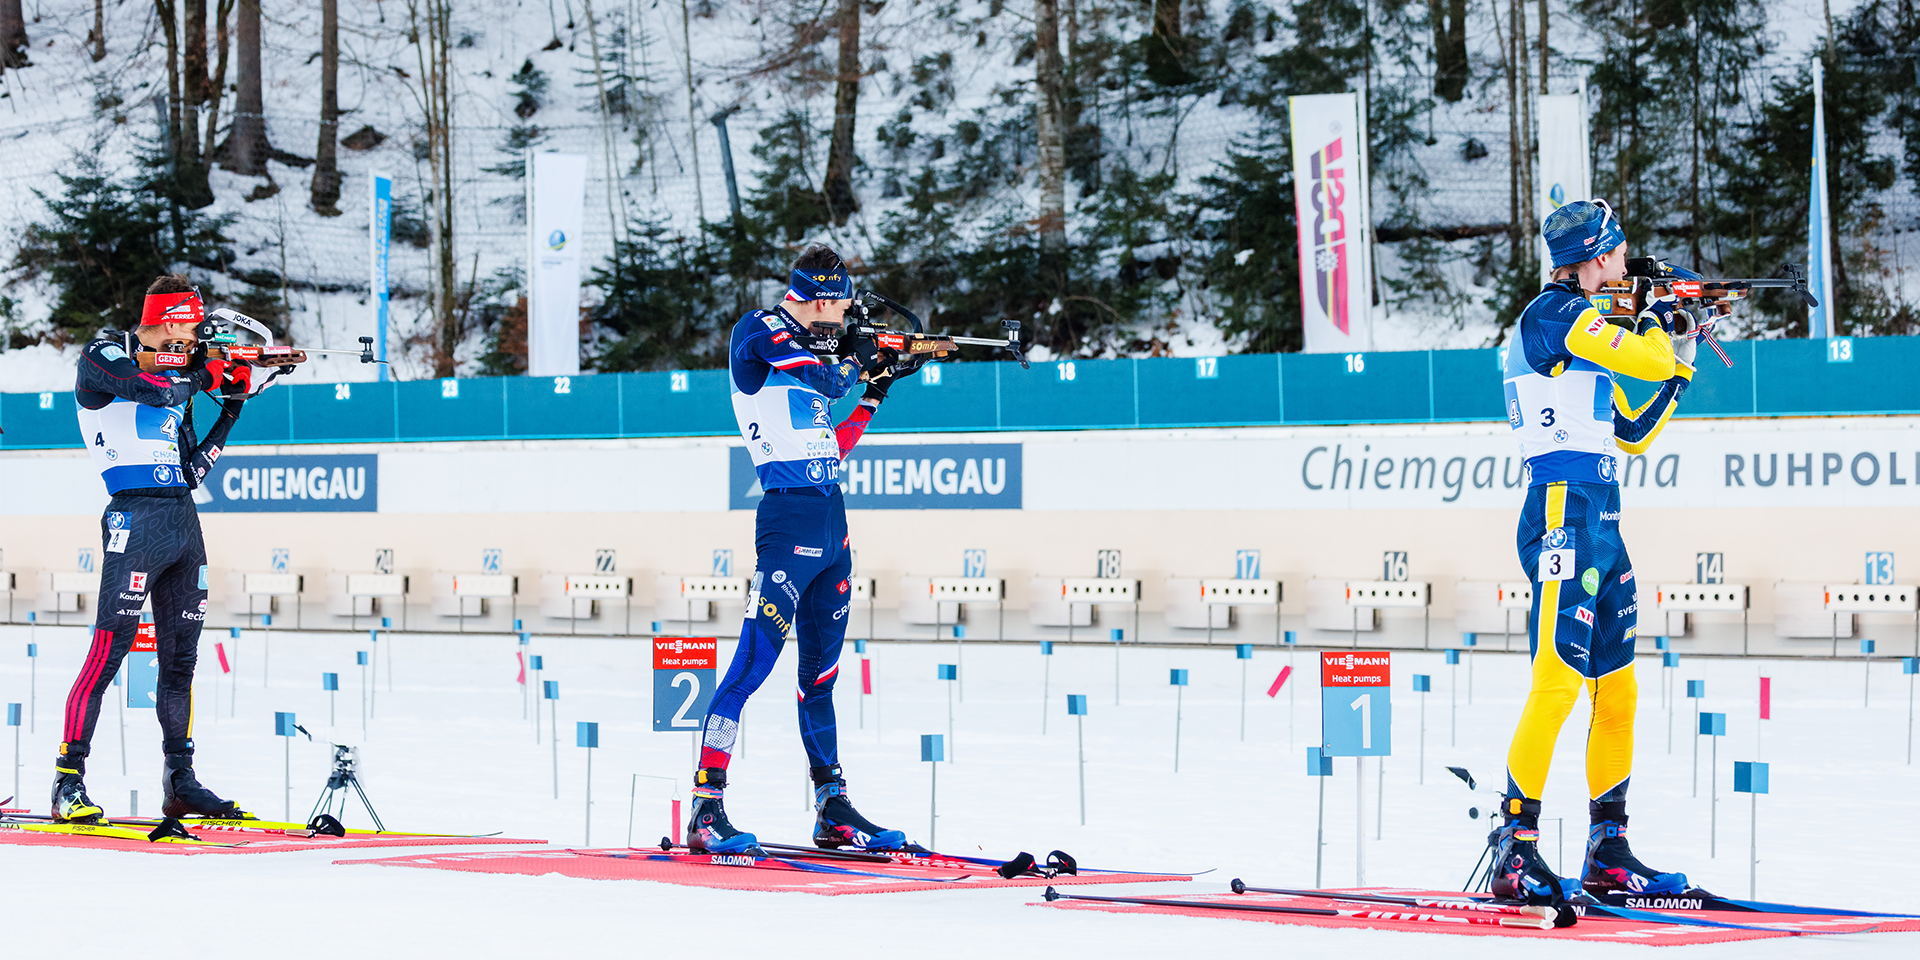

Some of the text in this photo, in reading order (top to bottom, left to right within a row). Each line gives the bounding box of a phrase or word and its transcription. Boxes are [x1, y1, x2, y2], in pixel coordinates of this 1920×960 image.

[233, 314, 252, 326] JOKA
[911, 341, 938, 351] somfy
[1830, 340, 1853, 361] 13
[158, 355, 184, 363] GEFRO
[1198, 358, 1216, 377] 17
[1345, 354, 1364, 373] 16
[923, 365, 940, 384] 19
[1057, 362, 1076, 381] 18
[442, 380, 458, 398] 23
[555, 376, 571, 394] 22
[671, 373, 688, 391] 21
[39, 393, 54, 409] 27
[335, 384, 350, 400] 24
[160, 414, 178, 440] 4
[1540, 408, 1555, 428] 3
[95, 431, 106, 447] 4
[749, 422, 761, 441] 2
[839, 458, 1005, 496] HIEMGAU
[1302, 445, 1525, 501] Chiemgau
[222, 466, 366, 501] CHIEMGAU
[377, 549, 393, 573] 24
[484, 550, 501, 574] 23
[596, 550, 615, 575] 22
[715, 550, 732, 576] 21
[965, 550, 985, 577] 19
[1099, 551, 1120, 578] 18
[1237, 550, 1259, 579] 17
[1385, 551, 1407, 581] 16
[1549, 553, 1562, 575] 3
[1697, 553, 1723, 583] 14
[1866, 553, 1893, 584] 13
[758, 596, 791, 640] somfy
[656, 640, 715, 653] VIESSMANN
[662, 657, 708, 667] Heat pumps
[1325, 654, 1389, 670] VIESSMANN
[1332, 675, 1381, 686] Heat pumps
[670, 671, 700, 728] 2
[1350, 694, 1371, 749] 1
[711, 856, 756, 867] SALOMON
[1625, 898, 1703, 910] SALOMON
